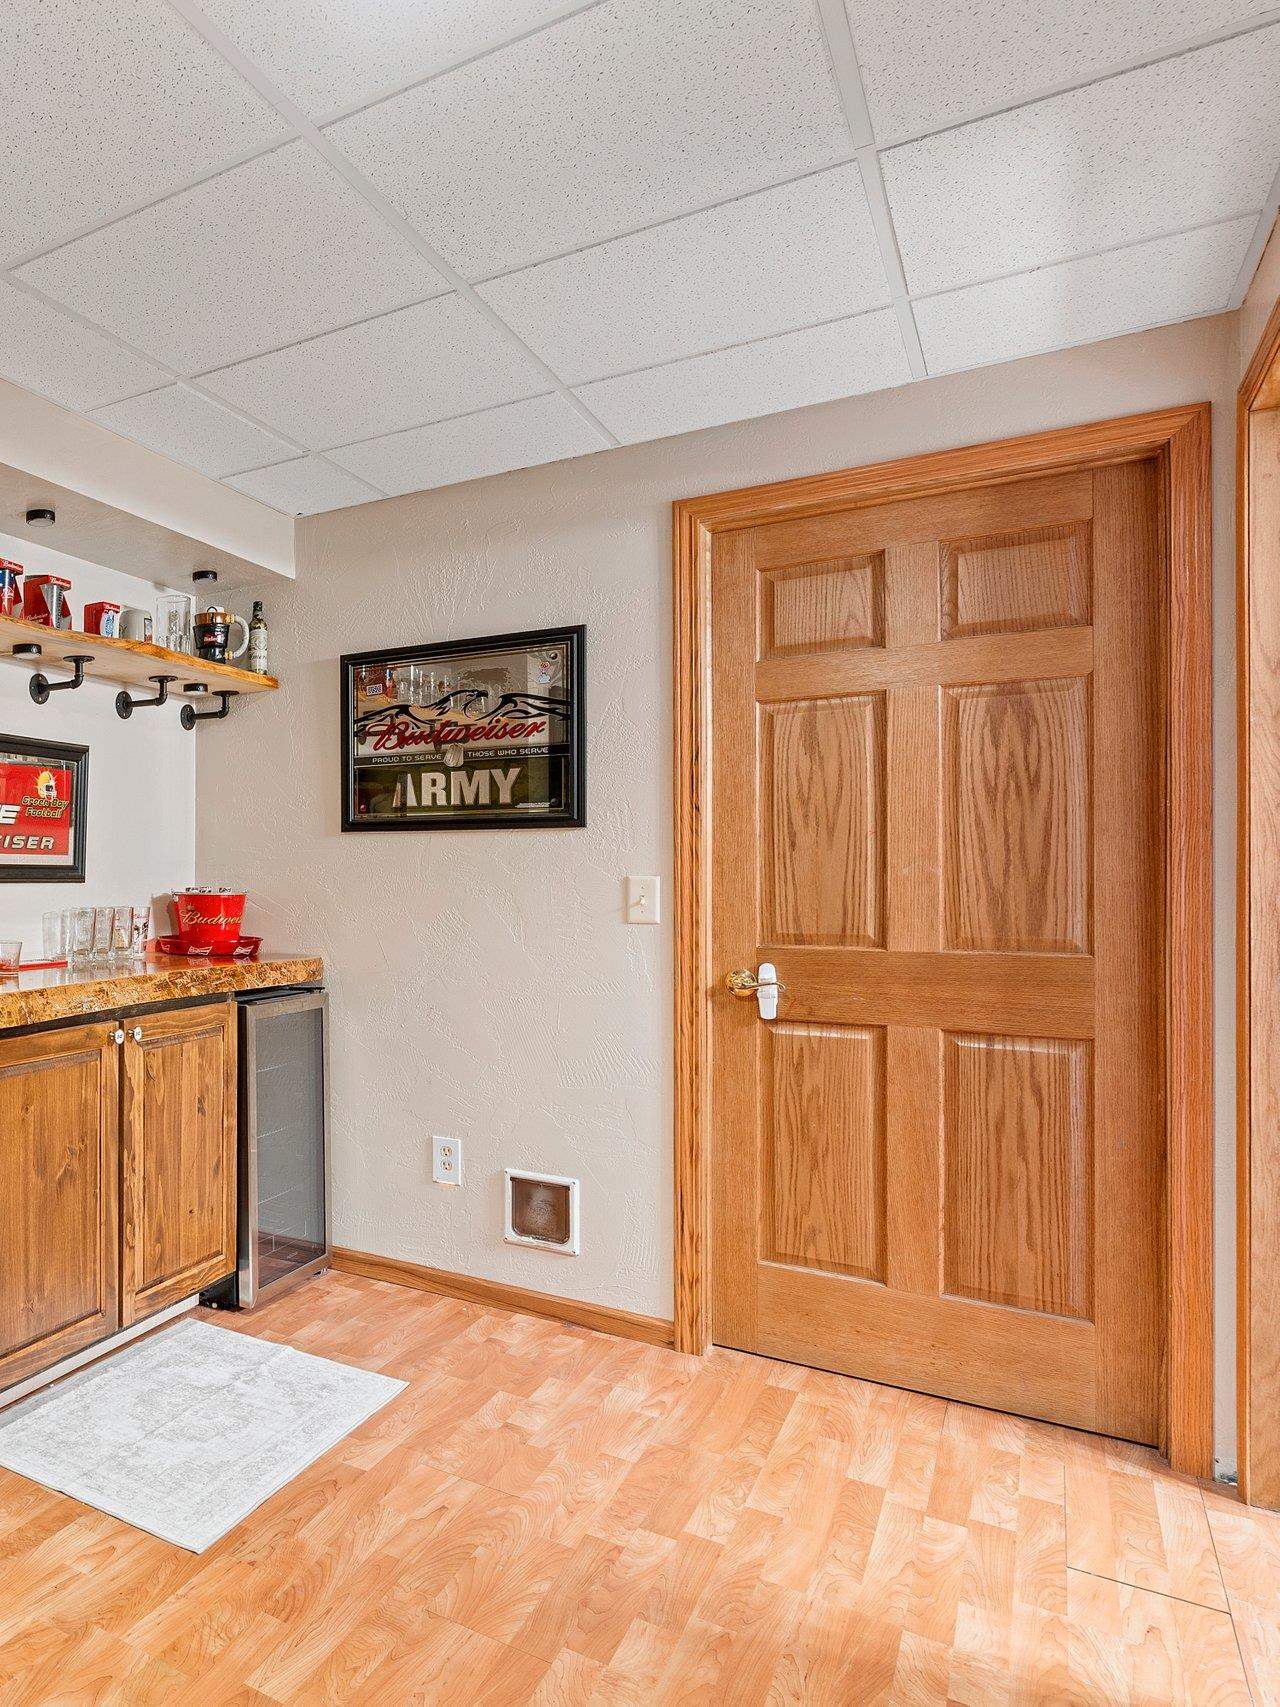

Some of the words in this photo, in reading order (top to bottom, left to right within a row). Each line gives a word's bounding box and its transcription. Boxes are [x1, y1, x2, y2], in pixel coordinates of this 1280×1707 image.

[365, 719, 547, 752] Budweiser
[372, 755, 400, 763] PROUD
[414, 753, 442, 761] SERVE
[467, 750, 494, 758] THOSE
[497, 748, 517, 756] WHO
[519, 746, 549, 755] SERVE
[393, 767, 521, 808] ARMY
[22, 795, 50, 807] Green
[51, 797, 70, 809] Bay
[25, 807, 63, 819] Football
